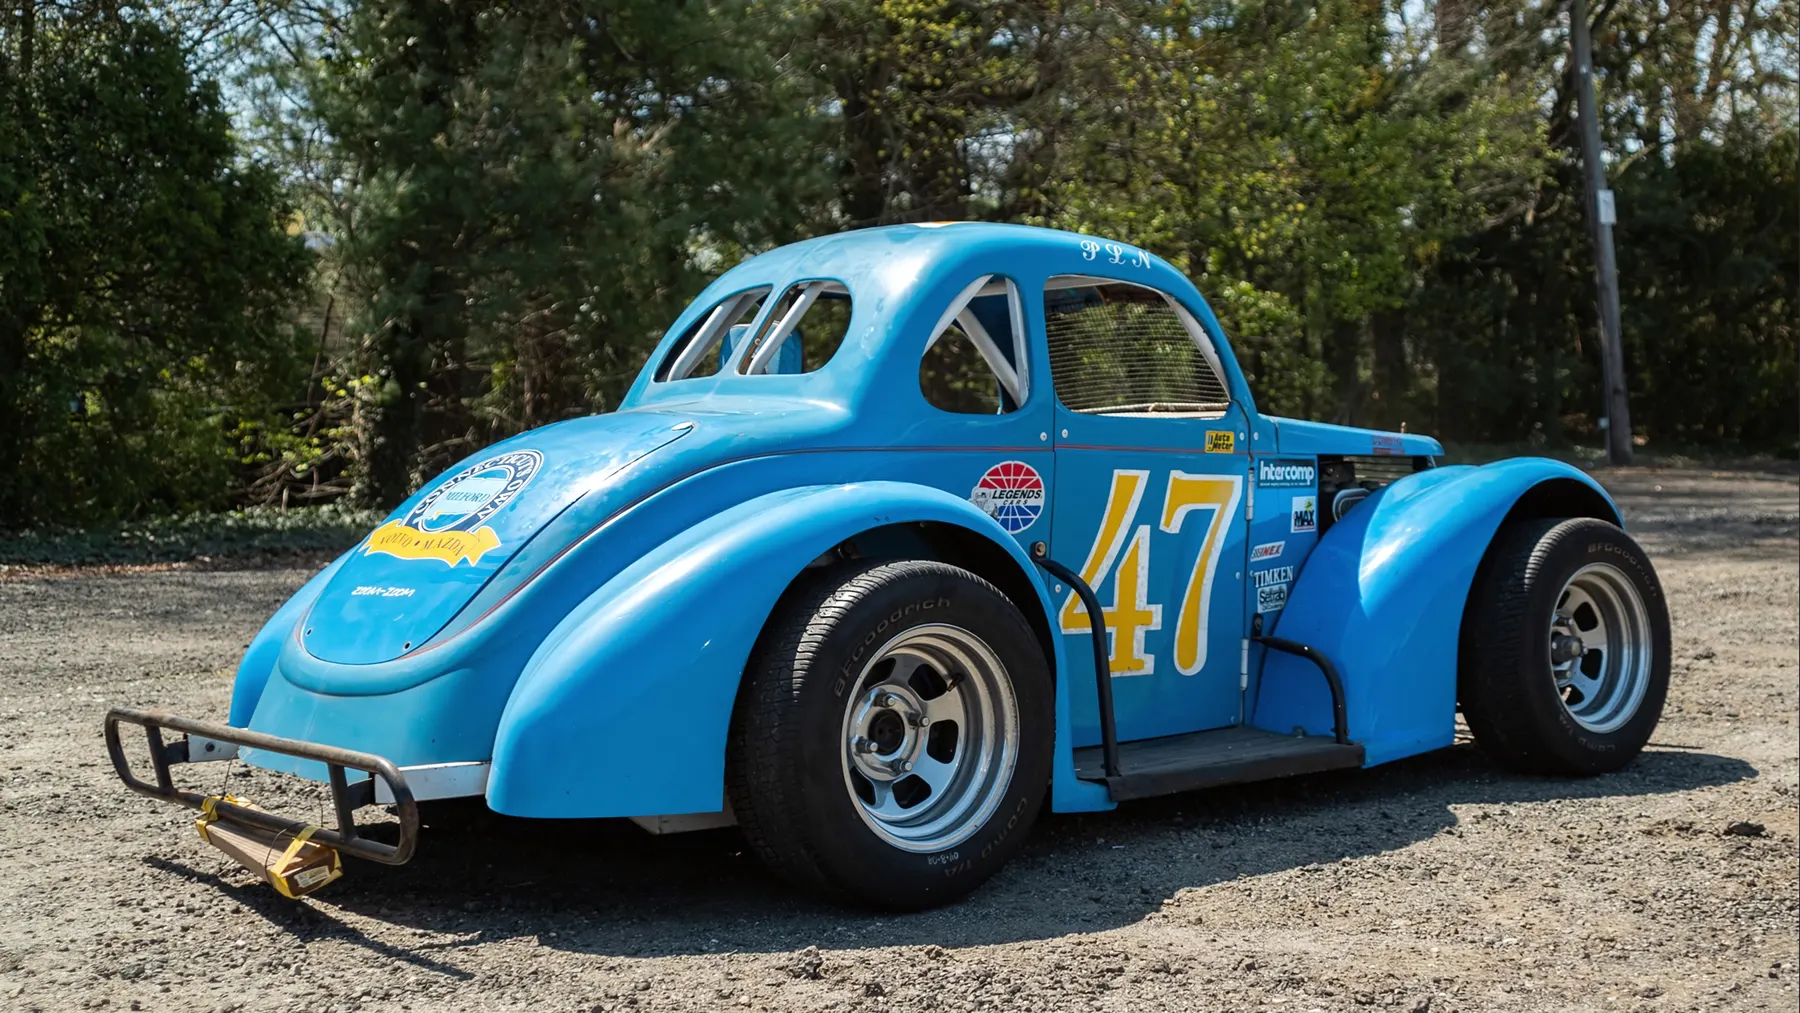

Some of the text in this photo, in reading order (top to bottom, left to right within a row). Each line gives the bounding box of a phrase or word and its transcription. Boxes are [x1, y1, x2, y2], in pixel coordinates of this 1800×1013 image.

[1260, 460, 1314, 486] Intercomp
[446, 491, 491, 503] MILFORD
[477, 479, 523, 520] OWN
[992, 489, 1042, 499] LEGENDS
[1294, 510, 1315, 527] MAX
[380, 532, 466, 556] VOLVO MAZDA
[1058, 469, 1243, 677] 47
[1254, 565, 1294, 588] TIMKEN
